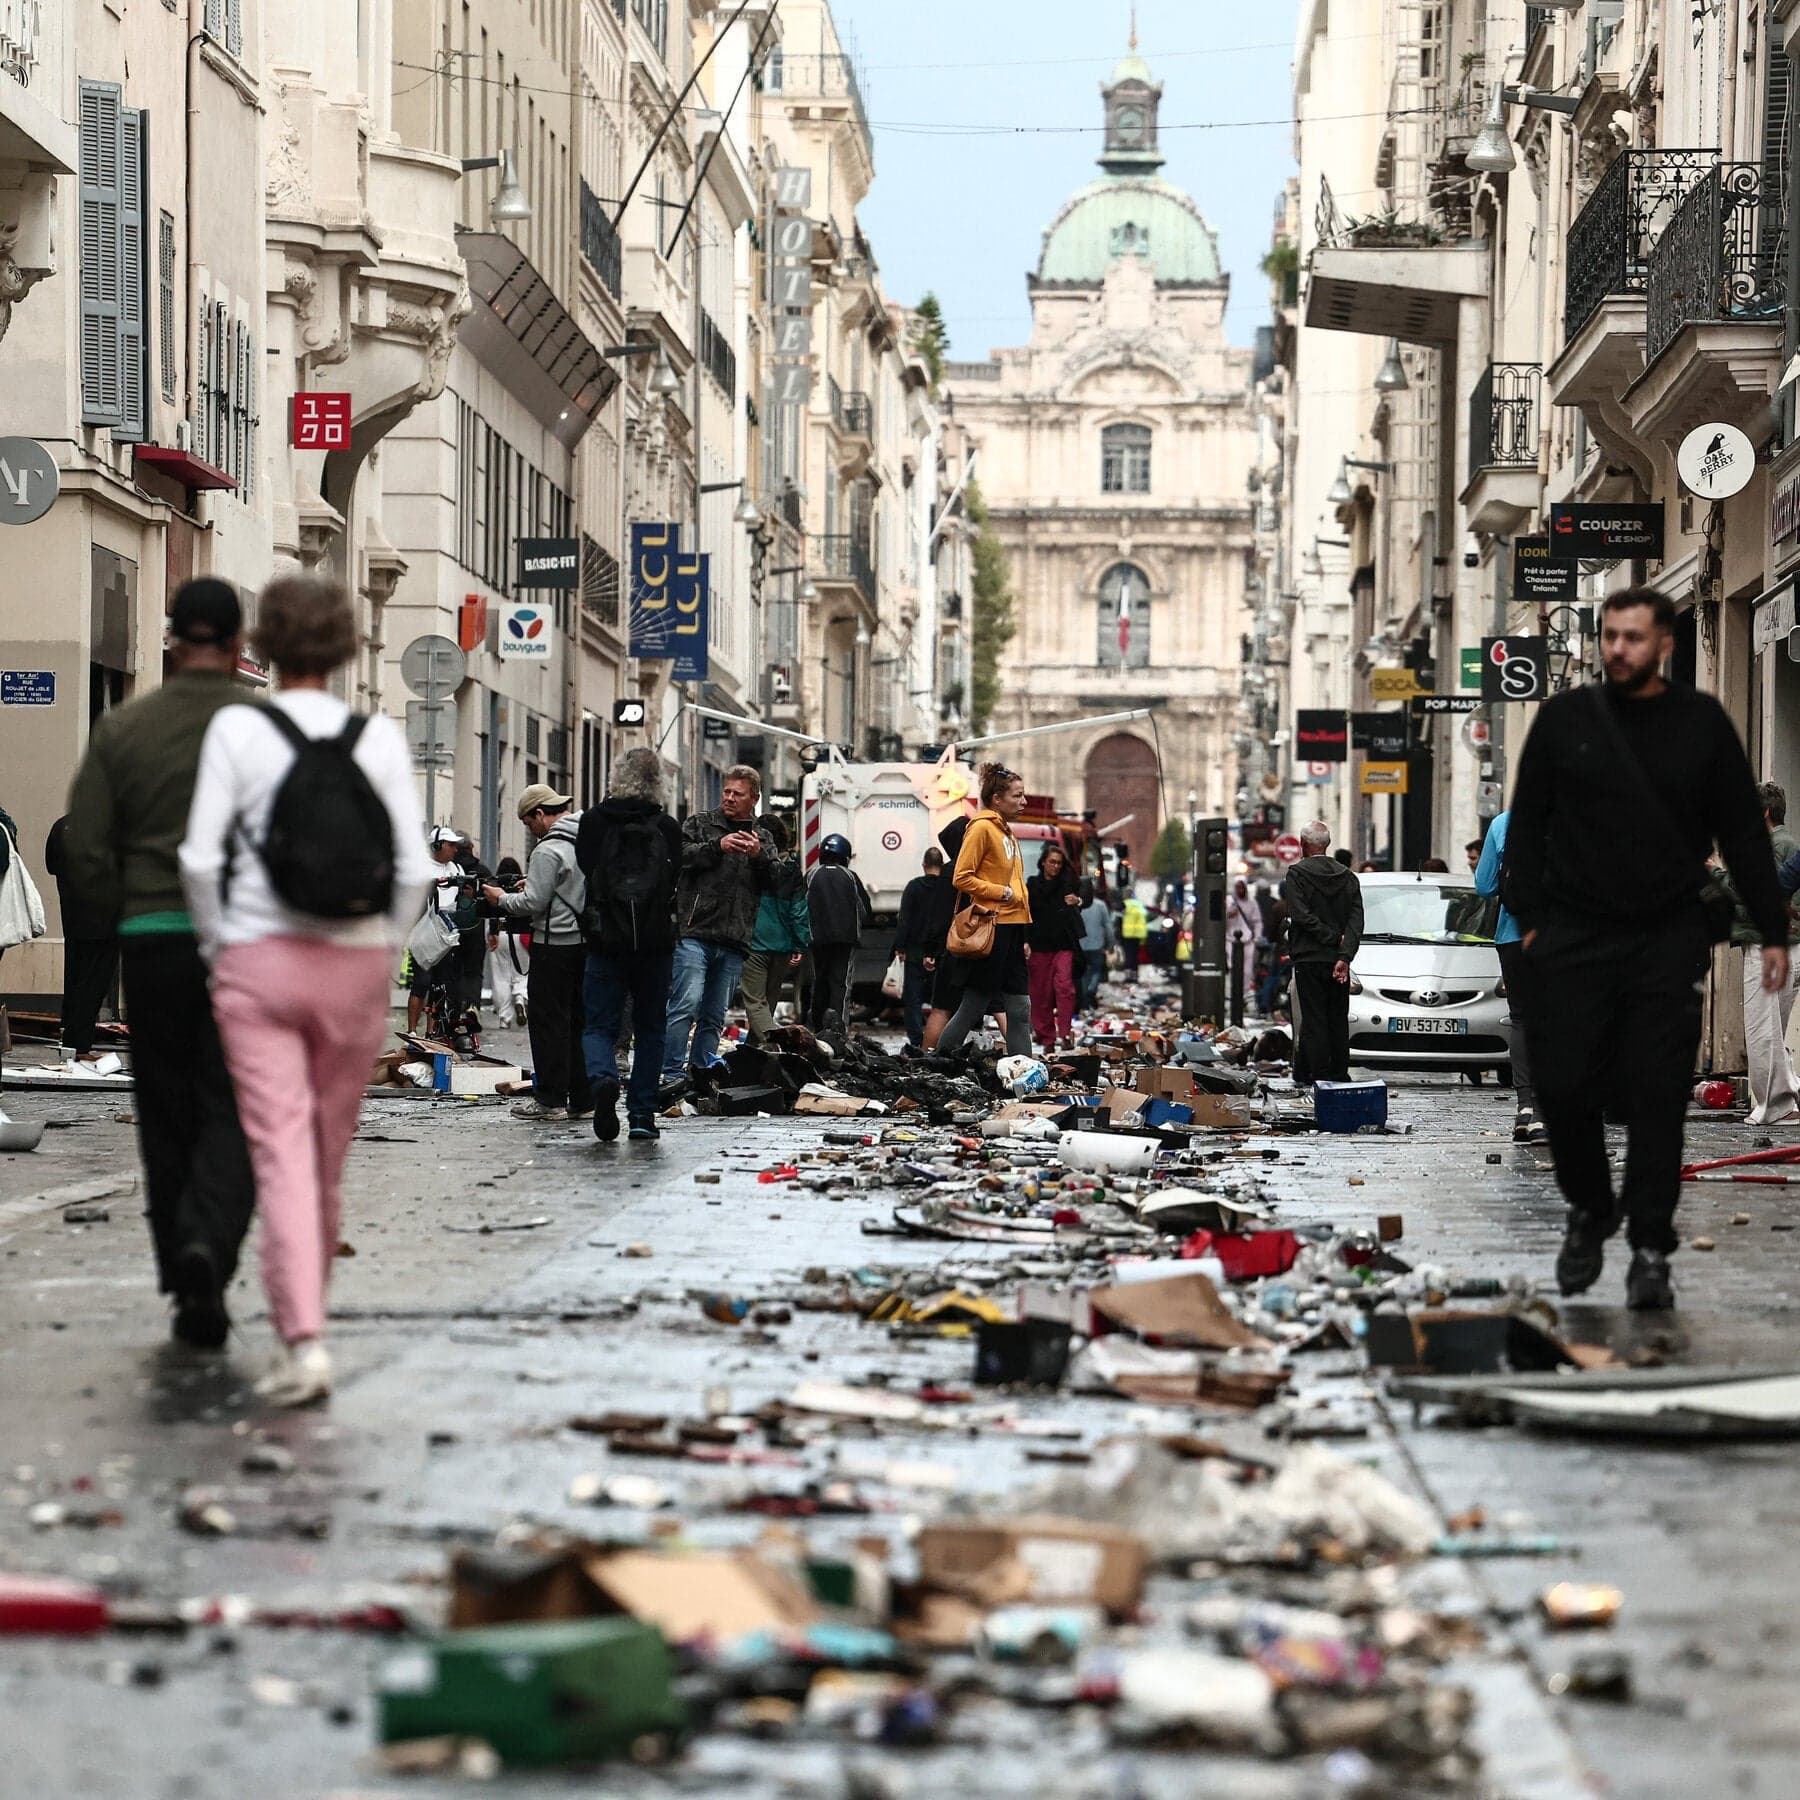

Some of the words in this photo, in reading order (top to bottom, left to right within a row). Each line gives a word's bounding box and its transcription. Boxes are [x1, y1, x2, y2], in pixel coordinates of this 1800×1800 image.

[780, 172, 807, 400] HOTEL
[1704, 449, 1726, 465] OAK
[1700, 454, 1734, 476] BERRY
[1579, 520, 1643, 531] COURIR
[641, 521, 669, 609] LCL
[676, 552, 700, 634] LCL
[503, 641, 546, 653] bouygues
[1425, 700, 1447, 710] POP
[878, 799, 920, 809] schmidt
[886, 836, 897, 846] 25
